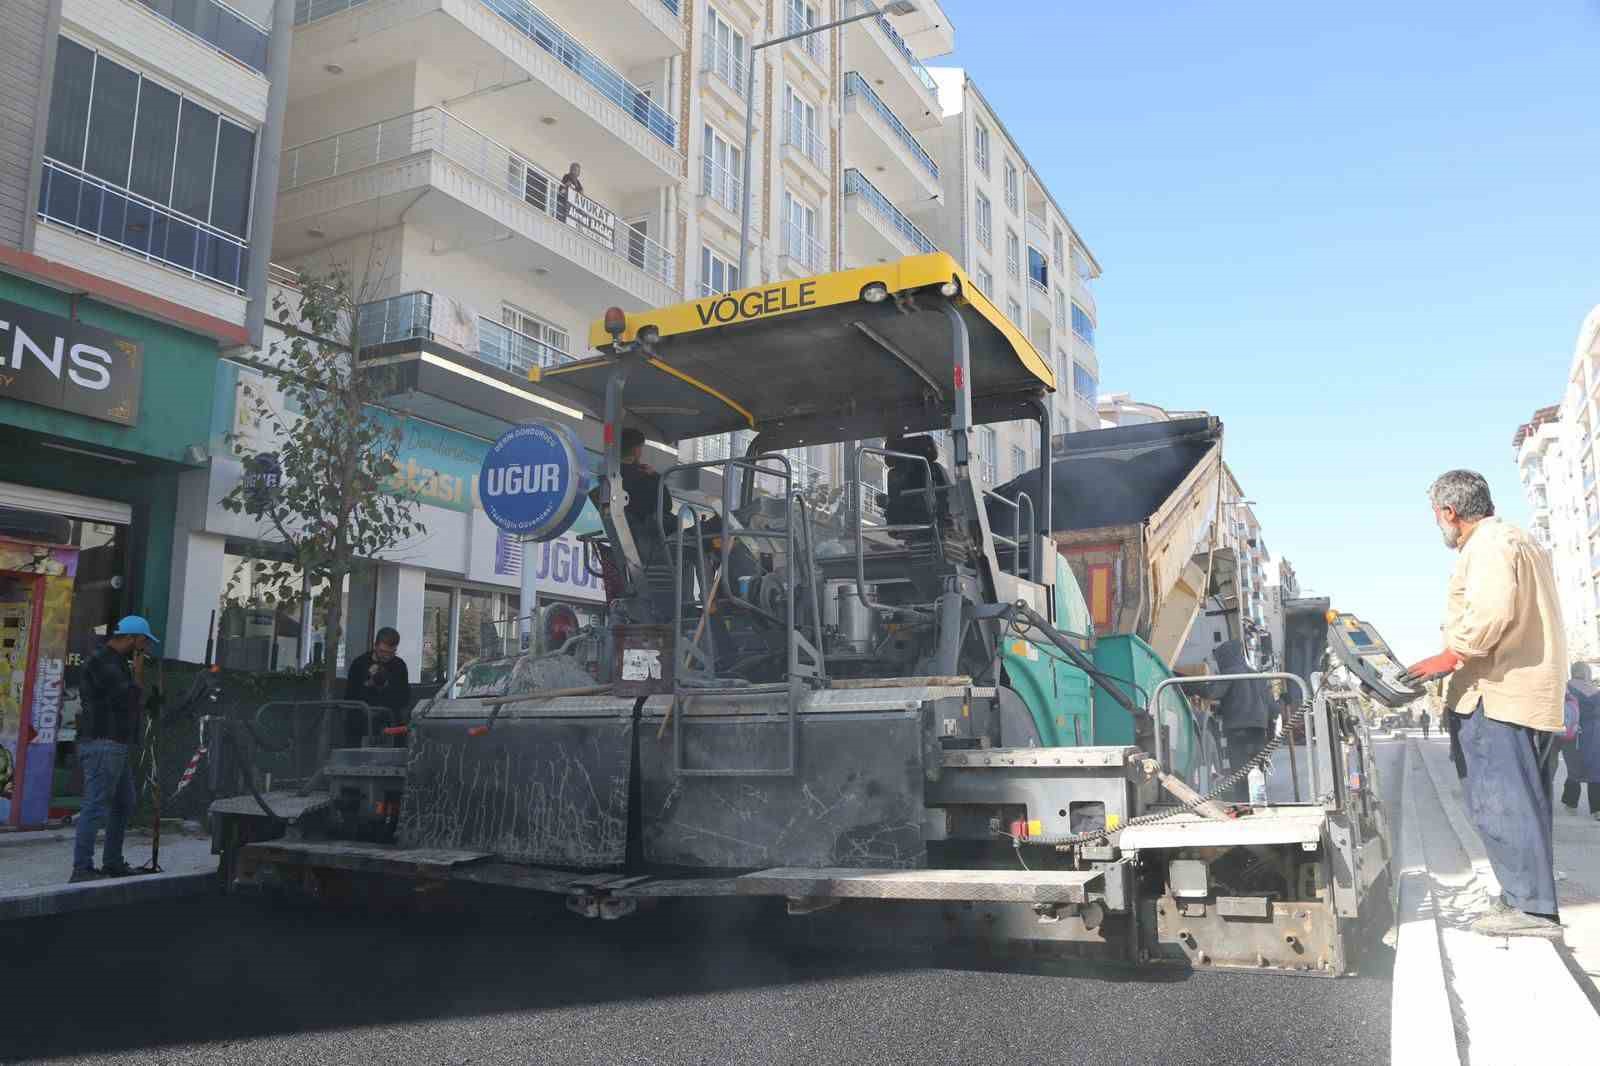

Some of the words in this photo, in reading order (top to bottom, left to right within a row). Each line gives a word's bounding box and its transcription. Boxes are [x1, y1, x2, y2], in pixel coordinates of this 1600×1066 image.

[696, 281, 816, 325] VÖGELE
[0, 321, 112, 390] NS
[488, 464, 560, 496] UĞUR
[39, 657, 64, 744] BOXING
